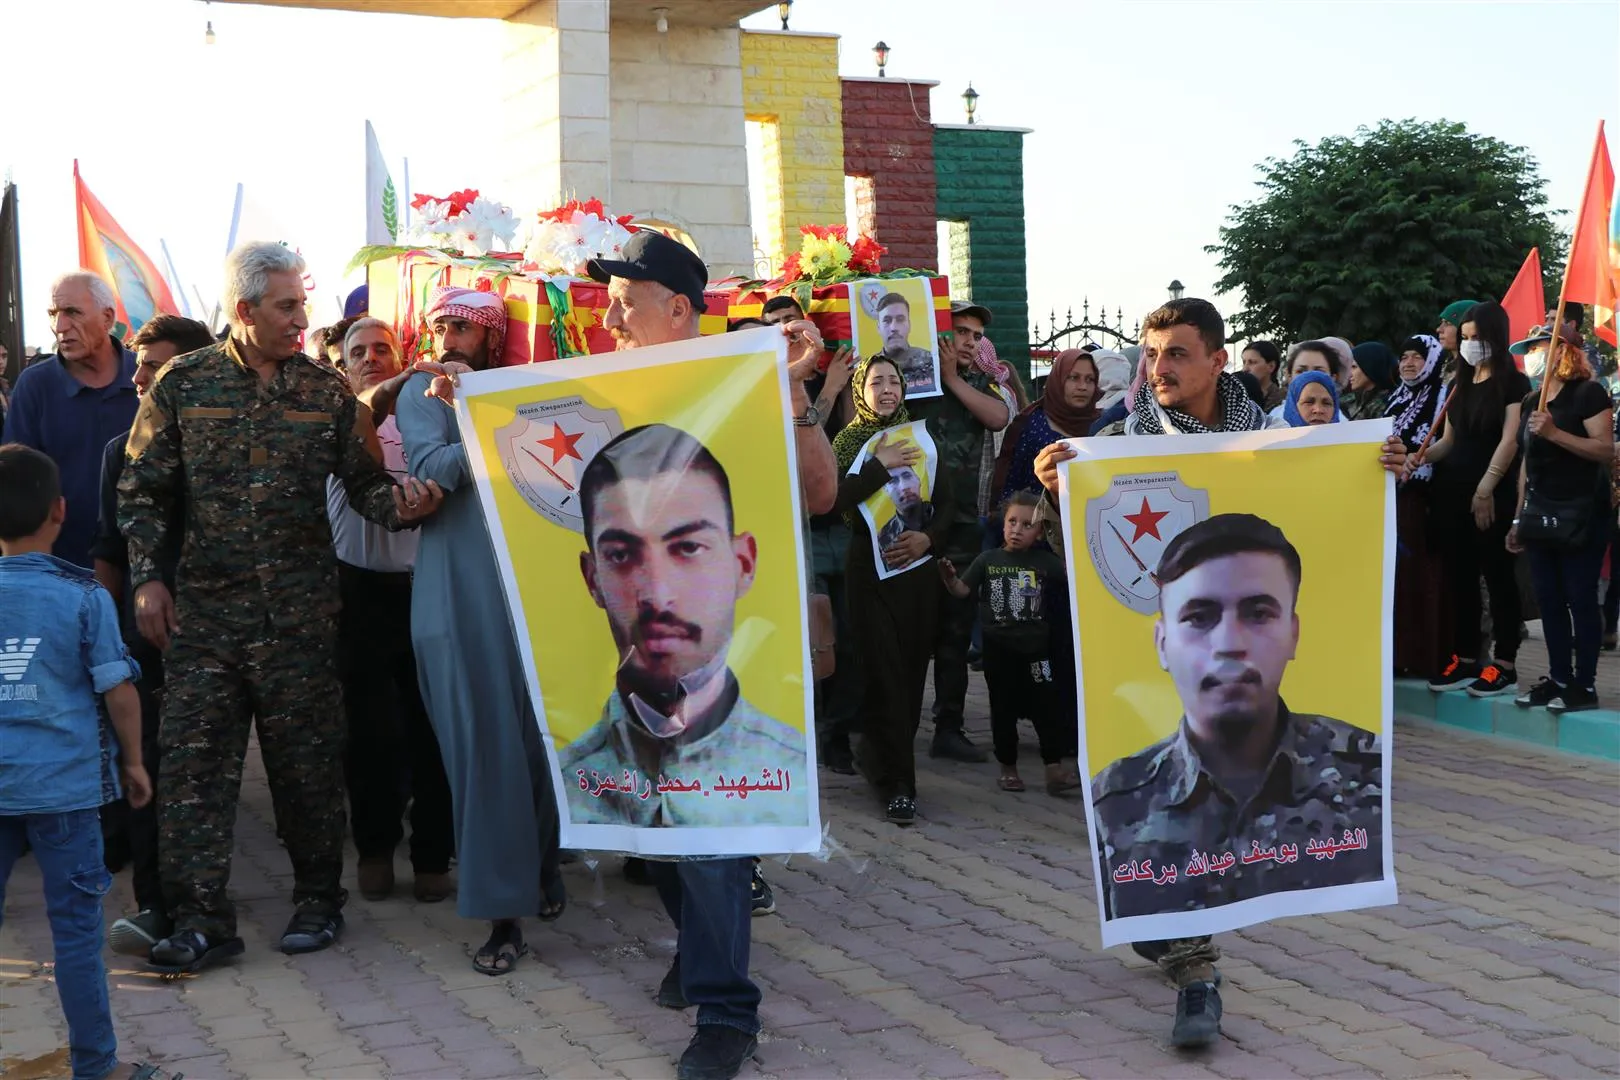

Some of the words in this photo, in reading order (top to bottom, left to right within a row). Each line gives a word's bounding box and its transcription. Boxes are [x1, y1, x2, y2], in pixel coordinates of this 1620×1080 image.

[619, 769, 651, 801] راش
[656, 774, 702, 794] محمد
[1241, 840, 1299, 865] يوسف
[1305, 828, 1368, 860] الشهيد
[1113, 859, 1177, 885] بركات
[1185, 849, 1236, 877] عبدالله
